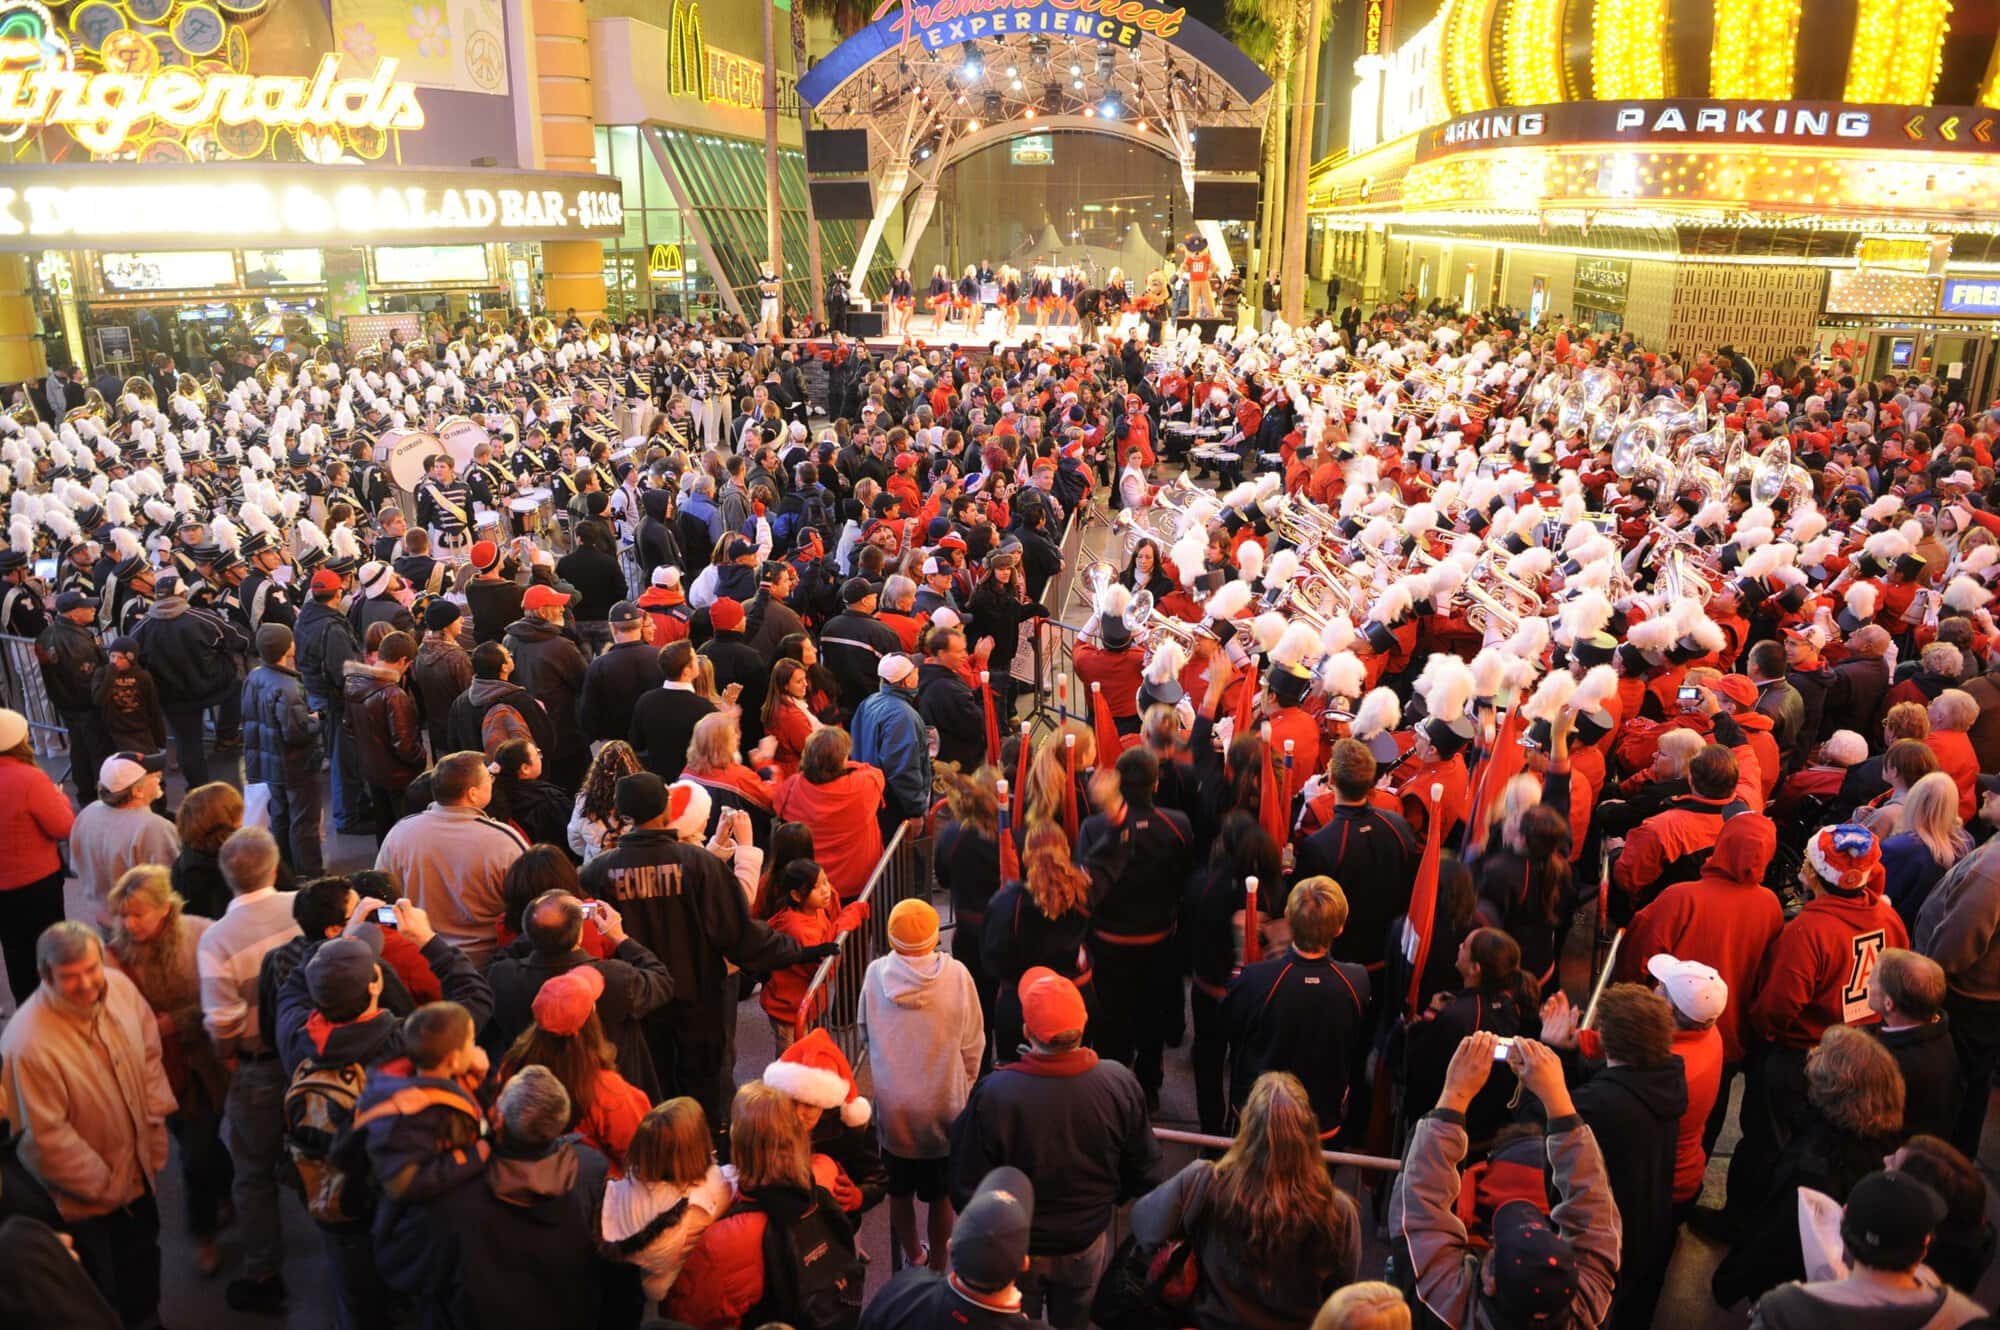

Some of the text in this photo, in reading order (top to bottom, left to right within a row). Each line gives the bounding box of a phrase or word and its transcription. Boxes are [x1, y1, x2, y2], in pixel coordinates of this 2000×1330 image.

[927, 12, 1136, 46] EXPERIENCE
[1049, 0, 1185, 37] reet
[1368, 0, 1381, 54] ANCE
[1616, 108, 1870, 137] PARKING
[499, 189, 567, 227] BAR
[1951, 285, 2000, 306] FRE
